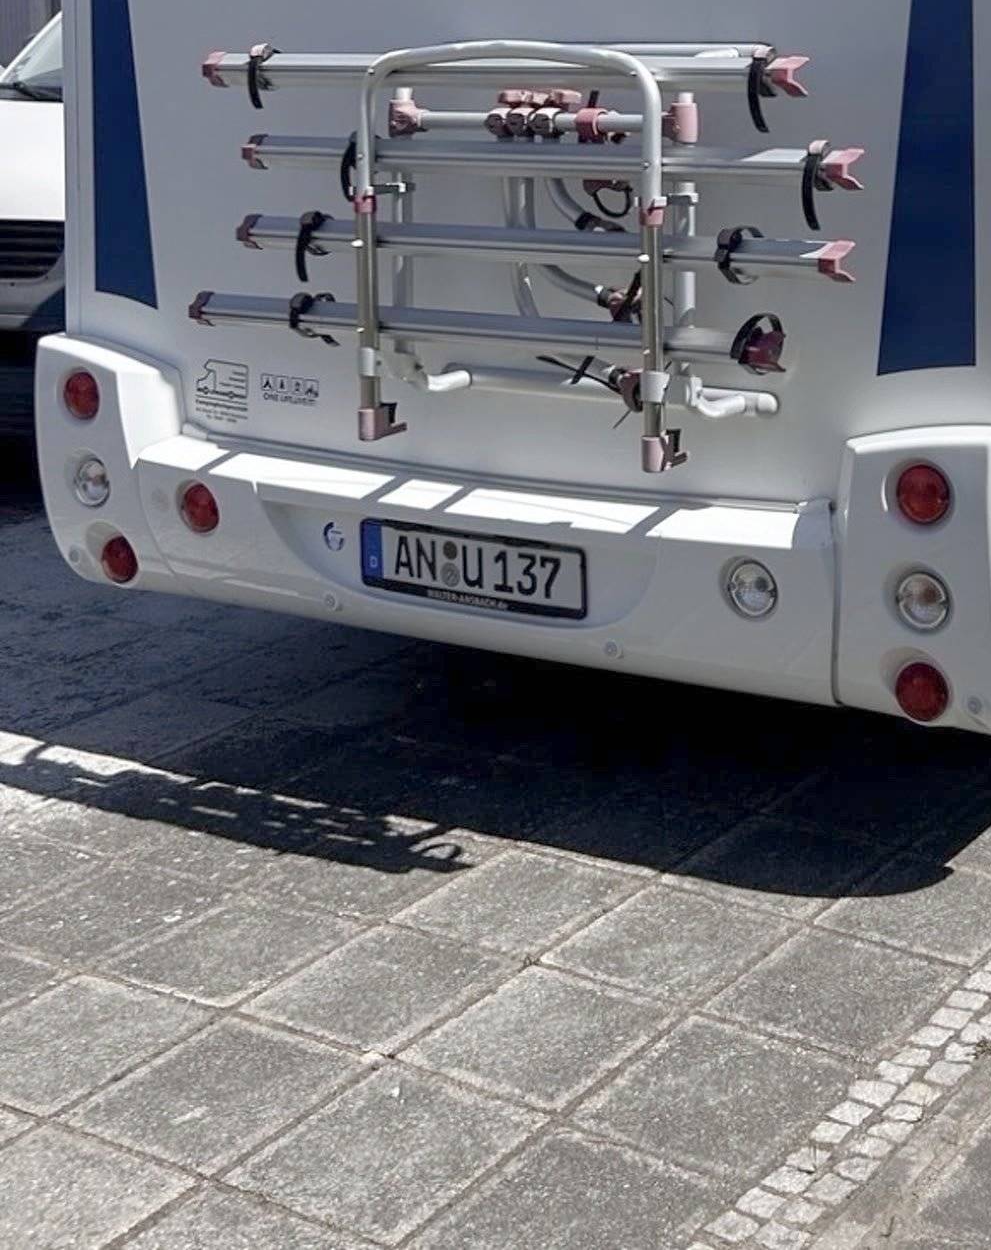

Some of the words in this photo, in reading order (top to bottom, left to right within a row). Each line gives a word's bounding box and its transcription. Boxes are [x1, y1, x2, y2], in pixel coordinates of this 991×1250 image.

[394, 535, 437, 581] AN
[462, 544, 484, 589] U
[493, 551, 562, 599] 137
